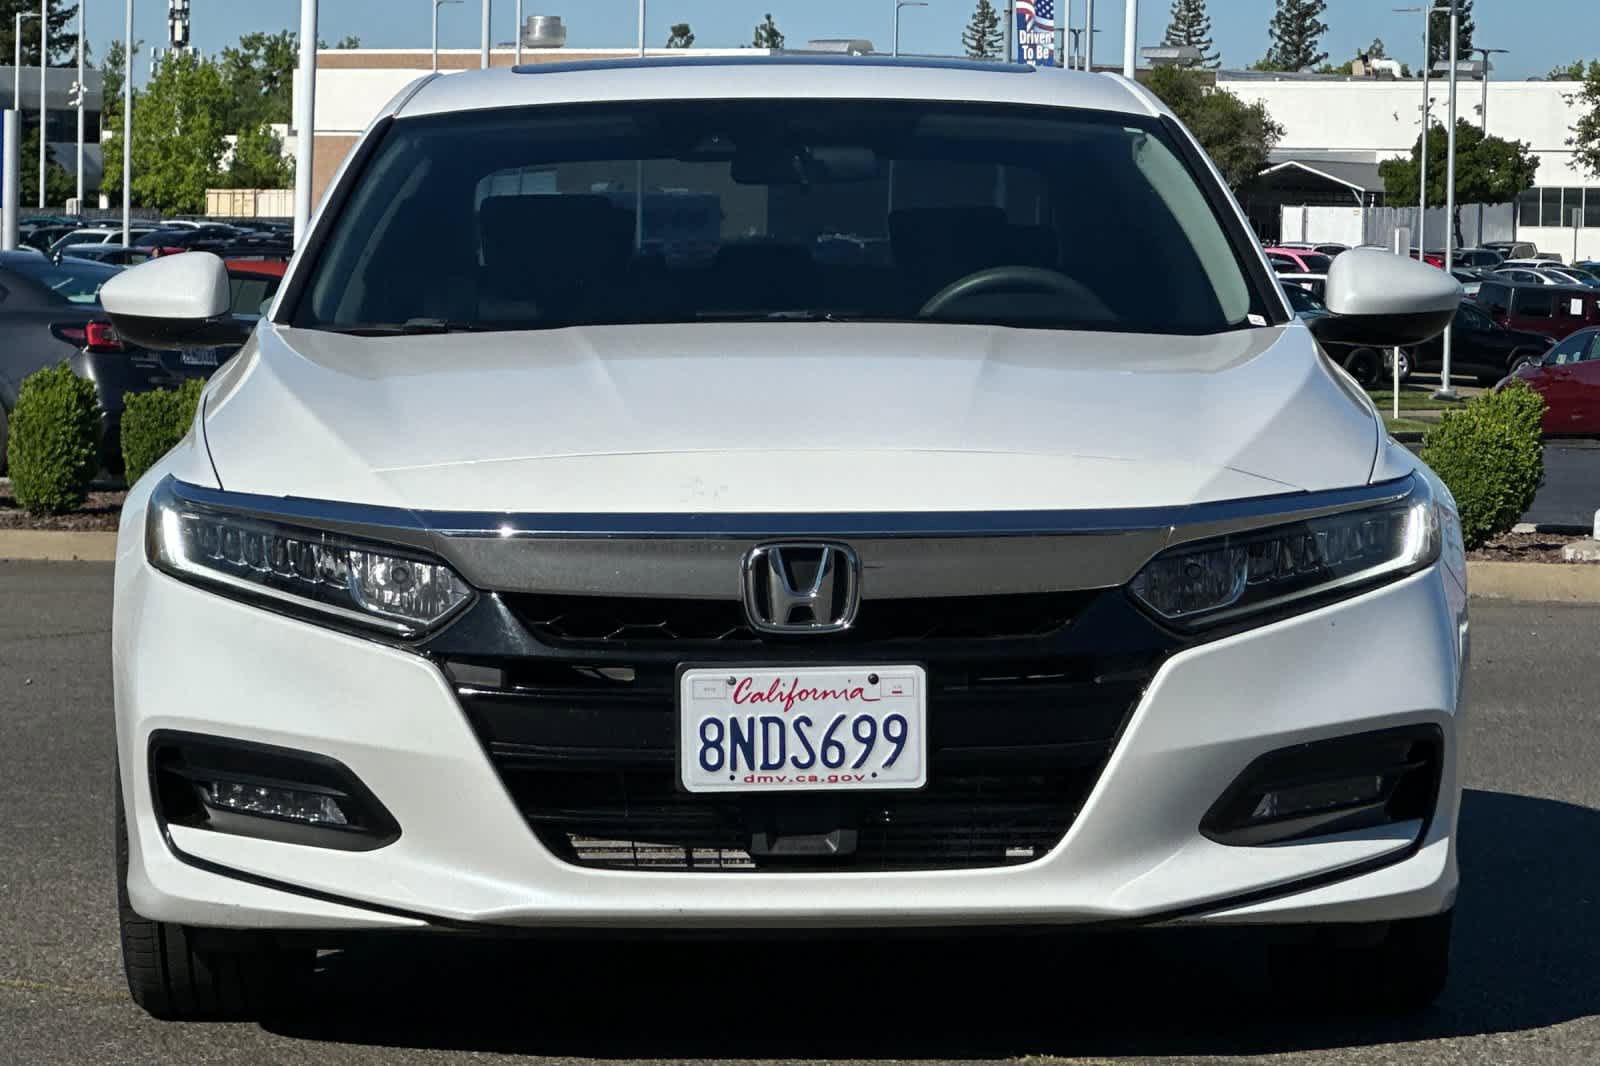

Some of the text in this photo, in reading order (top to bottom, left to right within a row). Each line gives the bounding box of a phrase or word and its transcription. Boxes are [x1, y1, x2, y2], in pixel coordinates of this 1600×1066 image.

[1019, 29, 1052, 45] Driven
[1021, 45, 1050, 60] To Be
[733, 677, 880, 712] California
[699, 713, 908, 772] 8NDS699
[743, 773, 865, 784] dmv.ca.gov
